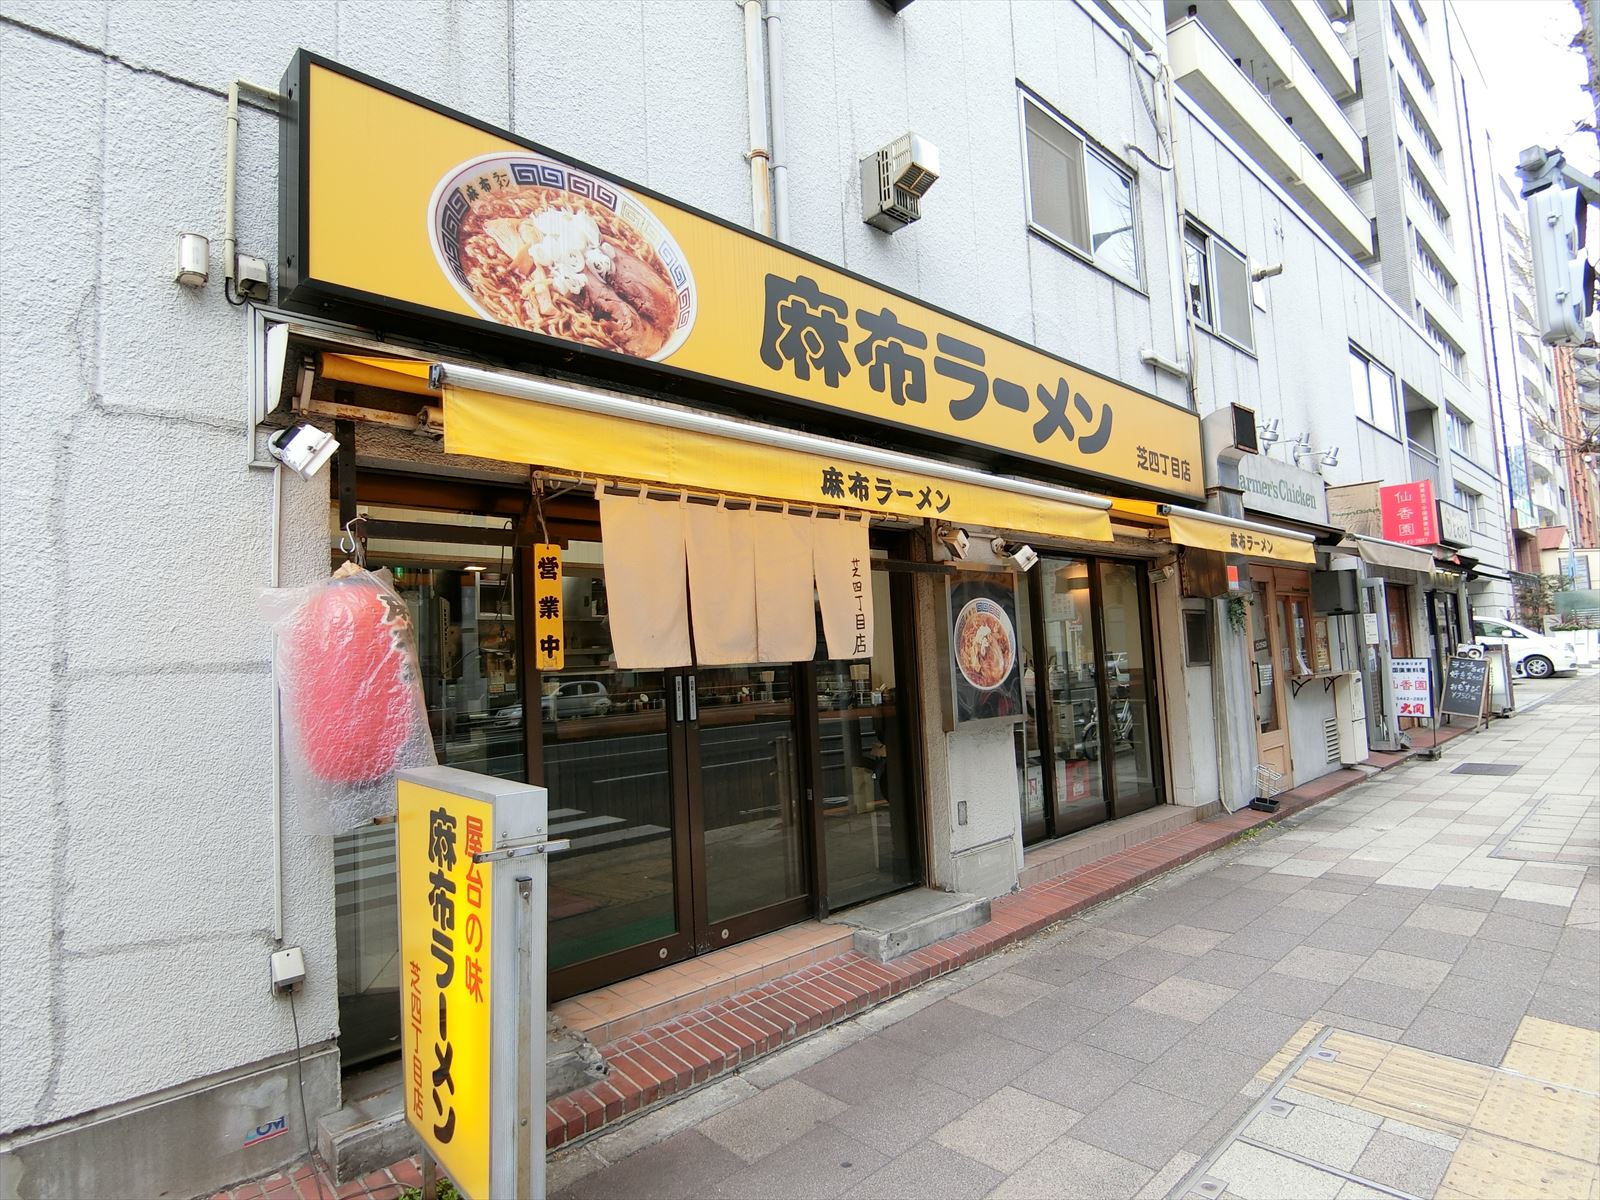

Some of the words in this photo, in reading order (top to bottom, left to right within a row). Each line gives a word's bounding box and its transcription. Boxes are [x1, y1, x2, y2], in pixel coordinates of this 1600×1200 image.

[759, 272, 1113, 455] 麻布ラーメン
[821, 465, 951, 513] 麻布ラーメン
[1136, 445, 1192, 482] 芝四丁目店
[1239, 474, 1279, 499] armer's
[1278, 479, 1317, 510] Chicken
[1230, 531, 1274, 554] 麻布ラーメン
[537, 555, 560, 659] 営業中
[851, 557, 868, 655] 芝四丁目店
[464, 815, 485, 1003] 屋台の味
[428, 806, 458, 1144] 麻布ラーメン
[409, 960, 424, 1121] 芝四丁目店
